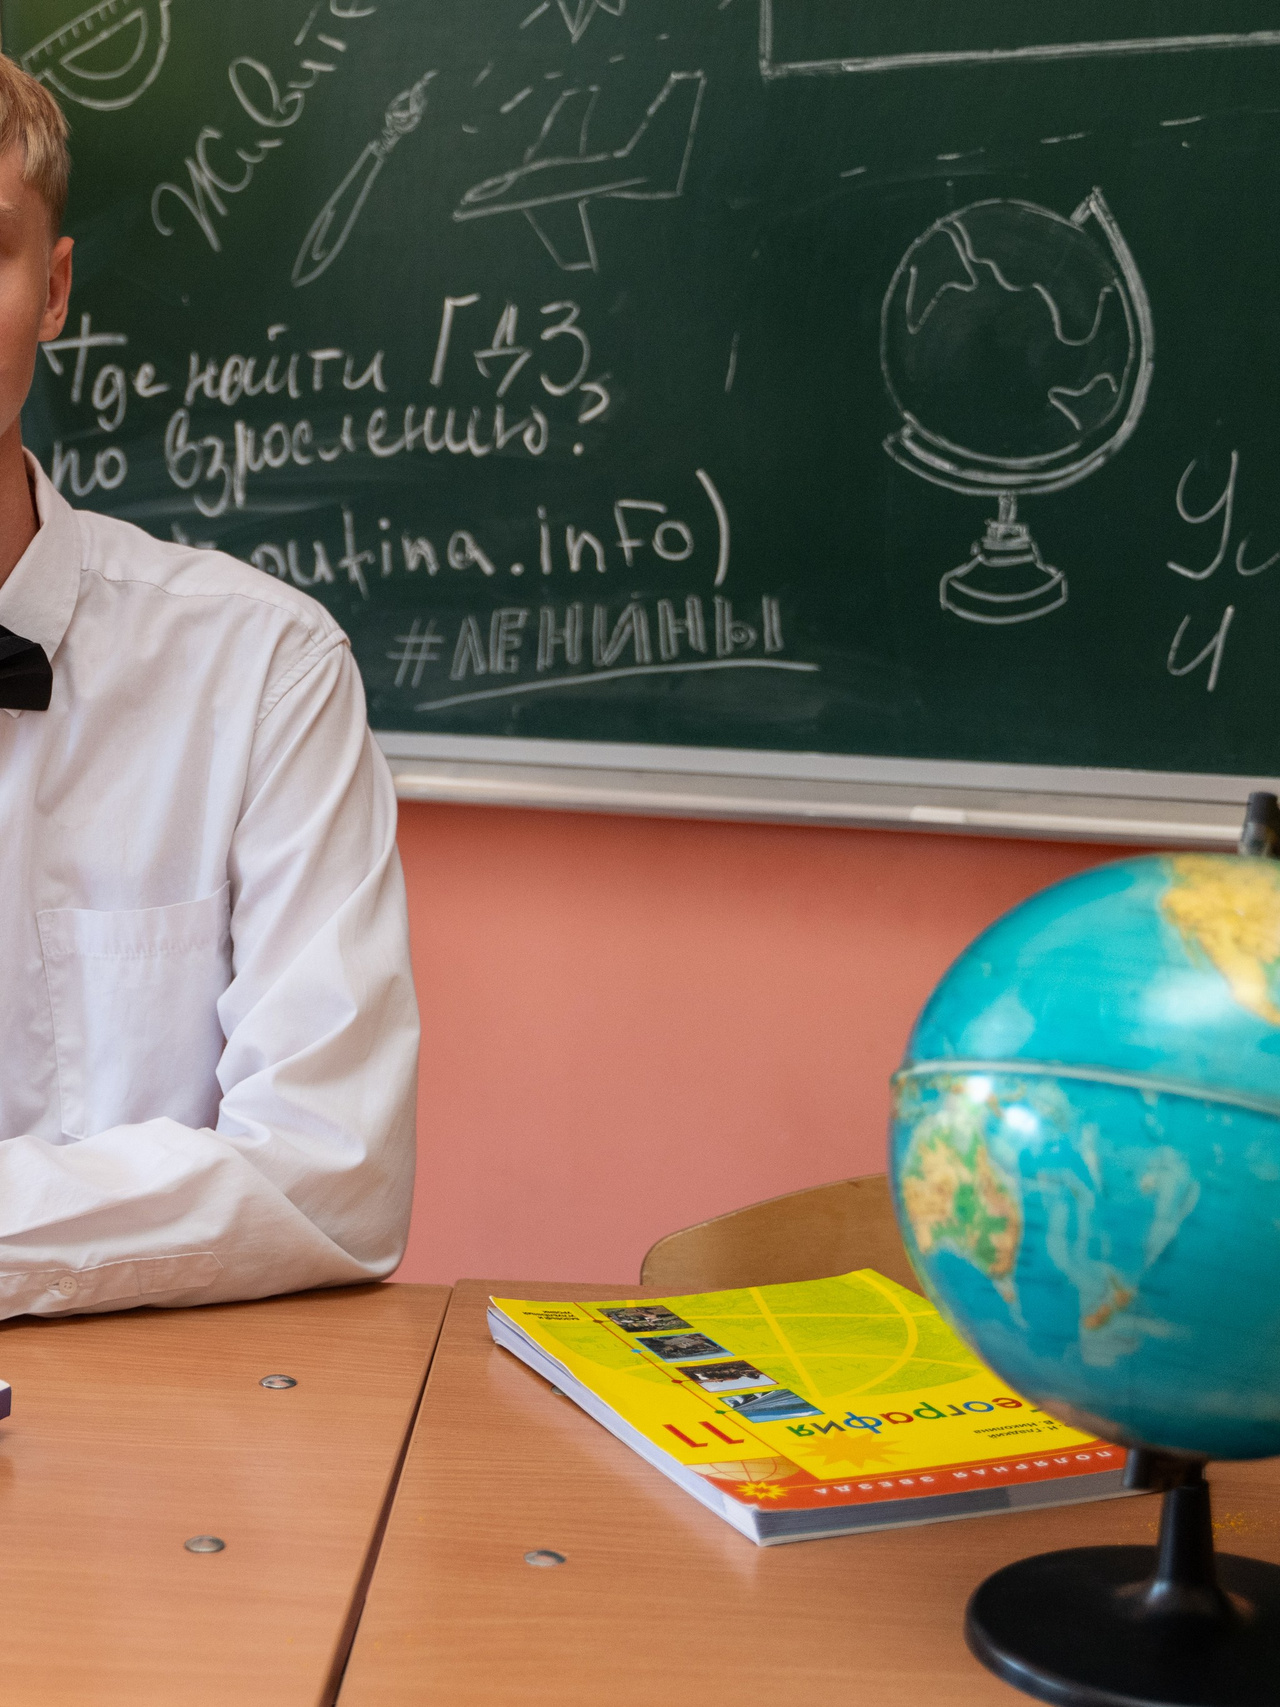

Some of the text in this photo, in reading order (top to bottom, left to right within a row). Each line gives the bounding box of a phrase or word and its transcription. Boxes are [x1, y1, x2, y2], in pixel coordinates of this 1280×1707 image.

[185, 325, 387, 405] найти
[430, 294, 591, 397] ГДЗ
[662, 1420, 744, 1449] 11
[786, 1397, 1040, 1438] еография
[813, 1451, 1113, 1495] ПОЛЯРНАЯ ЗВЕЗДА
